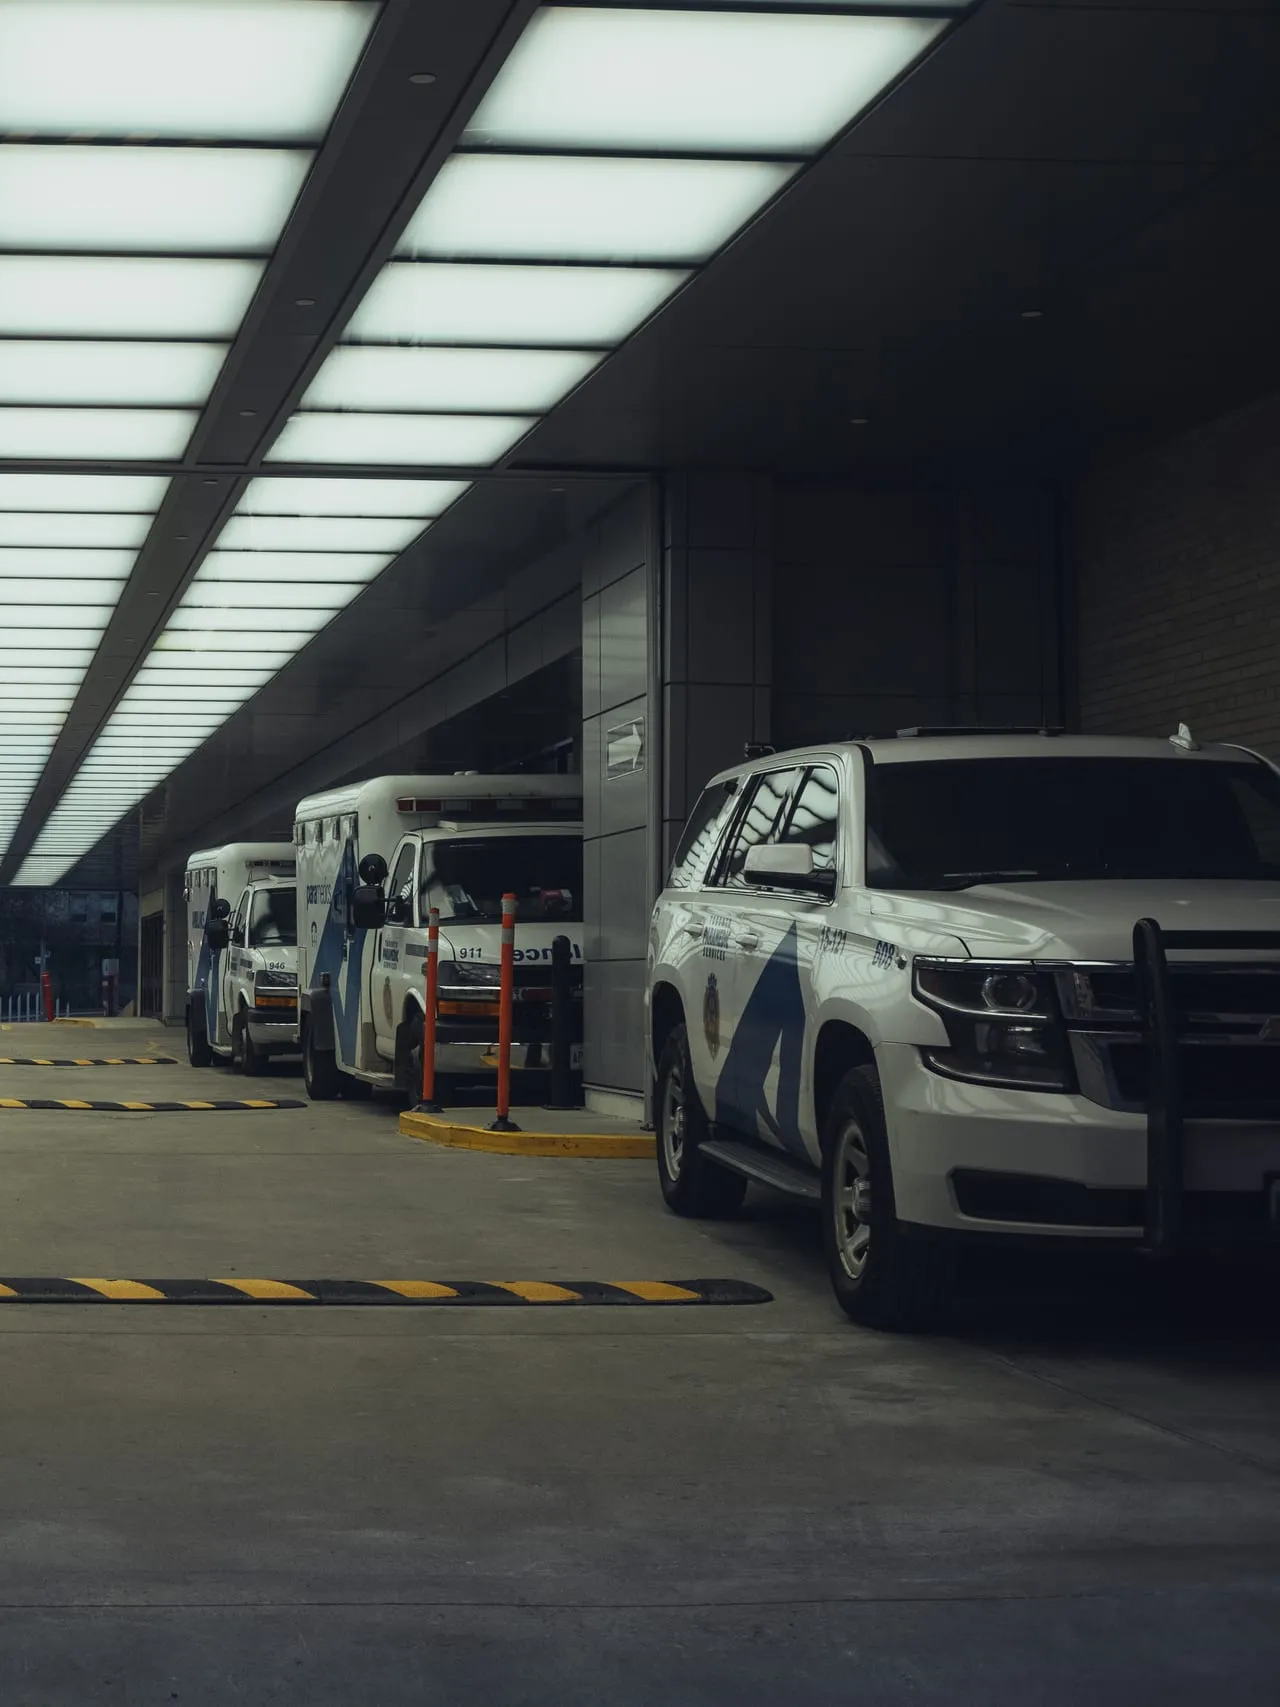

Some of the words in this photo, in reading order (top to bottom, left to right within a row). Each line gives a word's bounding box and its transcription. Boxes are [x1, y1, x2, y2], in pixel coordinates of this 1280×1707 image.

[459, 947, 482, 959] 911
[872, 940, 895, 970] 608
[269, 962, 285, 970] 946
